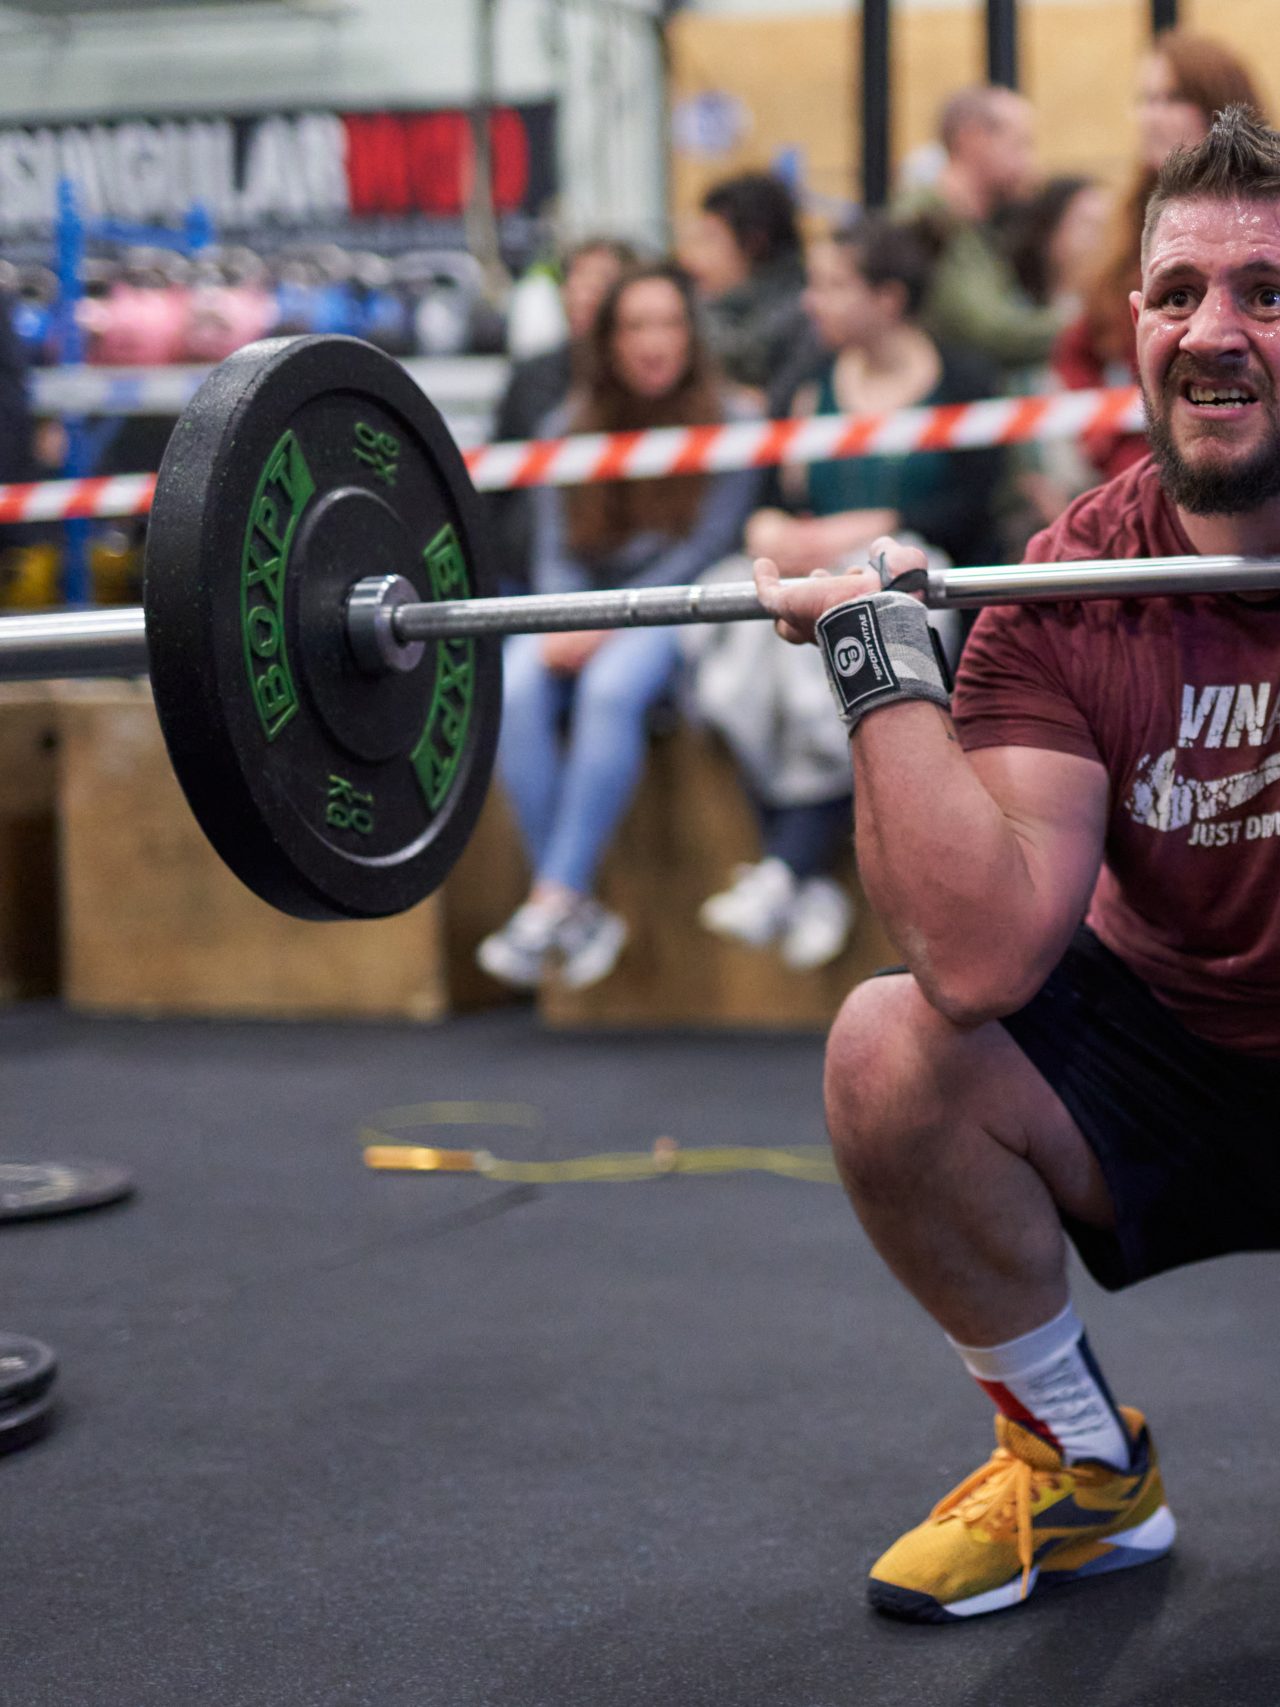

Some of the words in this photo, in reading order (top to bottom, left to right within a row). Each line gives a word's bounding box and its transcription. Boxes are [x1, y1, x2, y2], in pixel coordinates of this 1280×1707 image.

[247, 451, 297, 720] BOXPT
[426, 542, 471, 792] BXPT
[1188, 820, 1242, 847] JUST
